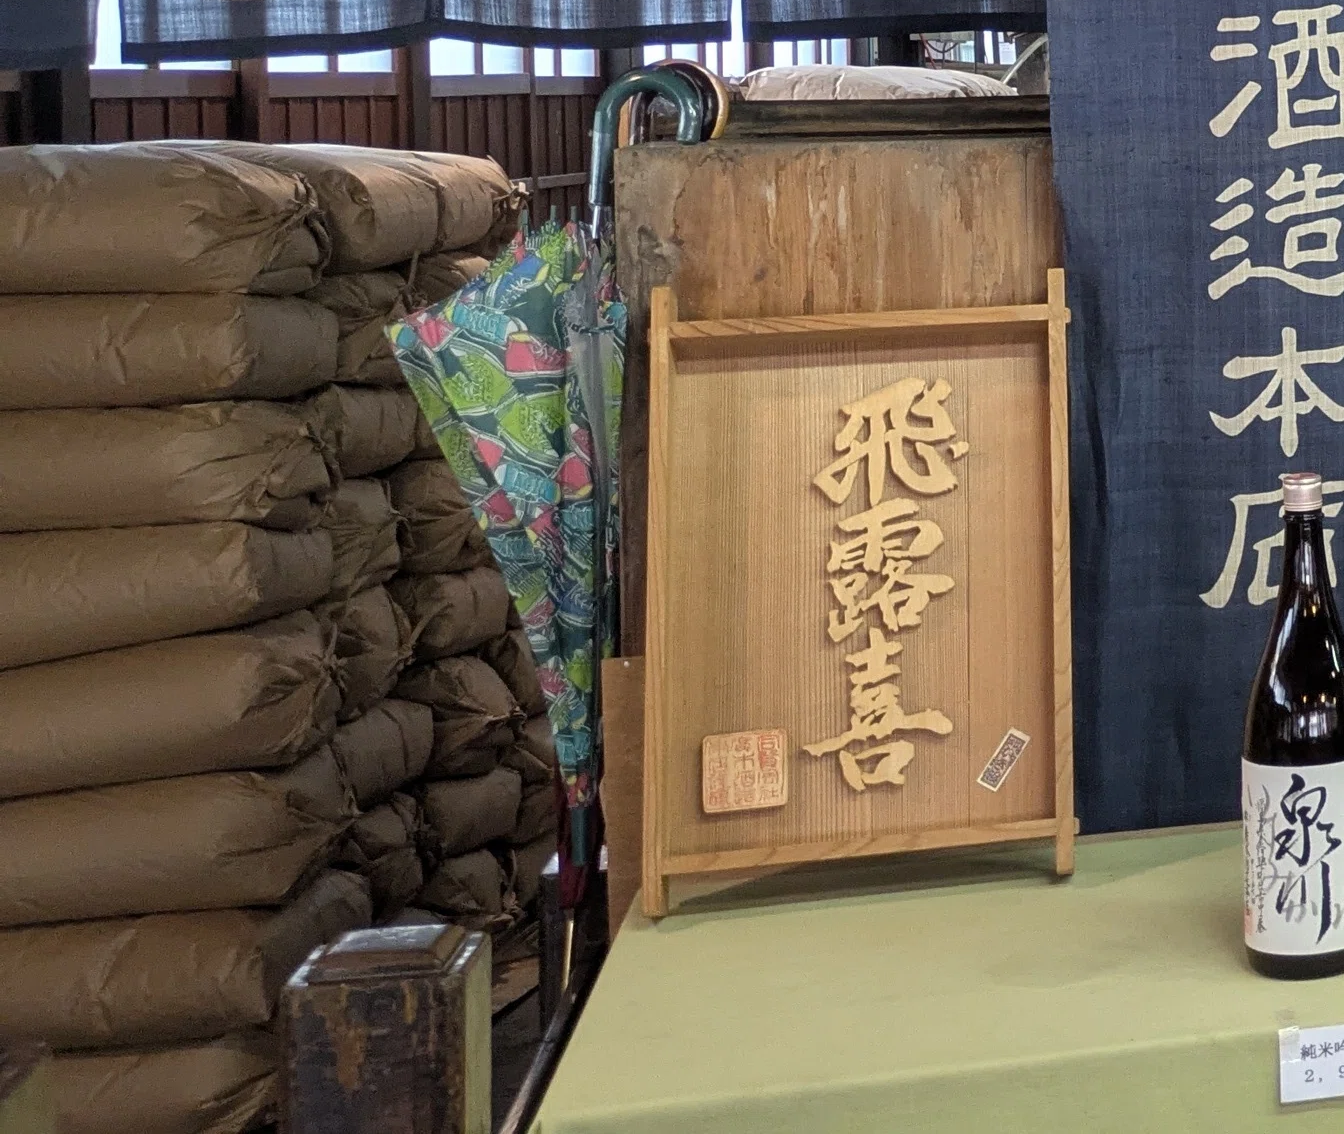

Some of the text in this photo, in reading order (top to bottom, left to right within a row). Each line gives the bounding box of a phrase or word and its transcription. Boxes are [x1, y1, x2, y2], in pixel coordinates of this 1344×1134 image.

[802, 377, 969, 792] 飛露喜
[1274, 773, 1342, 945] 泉川
